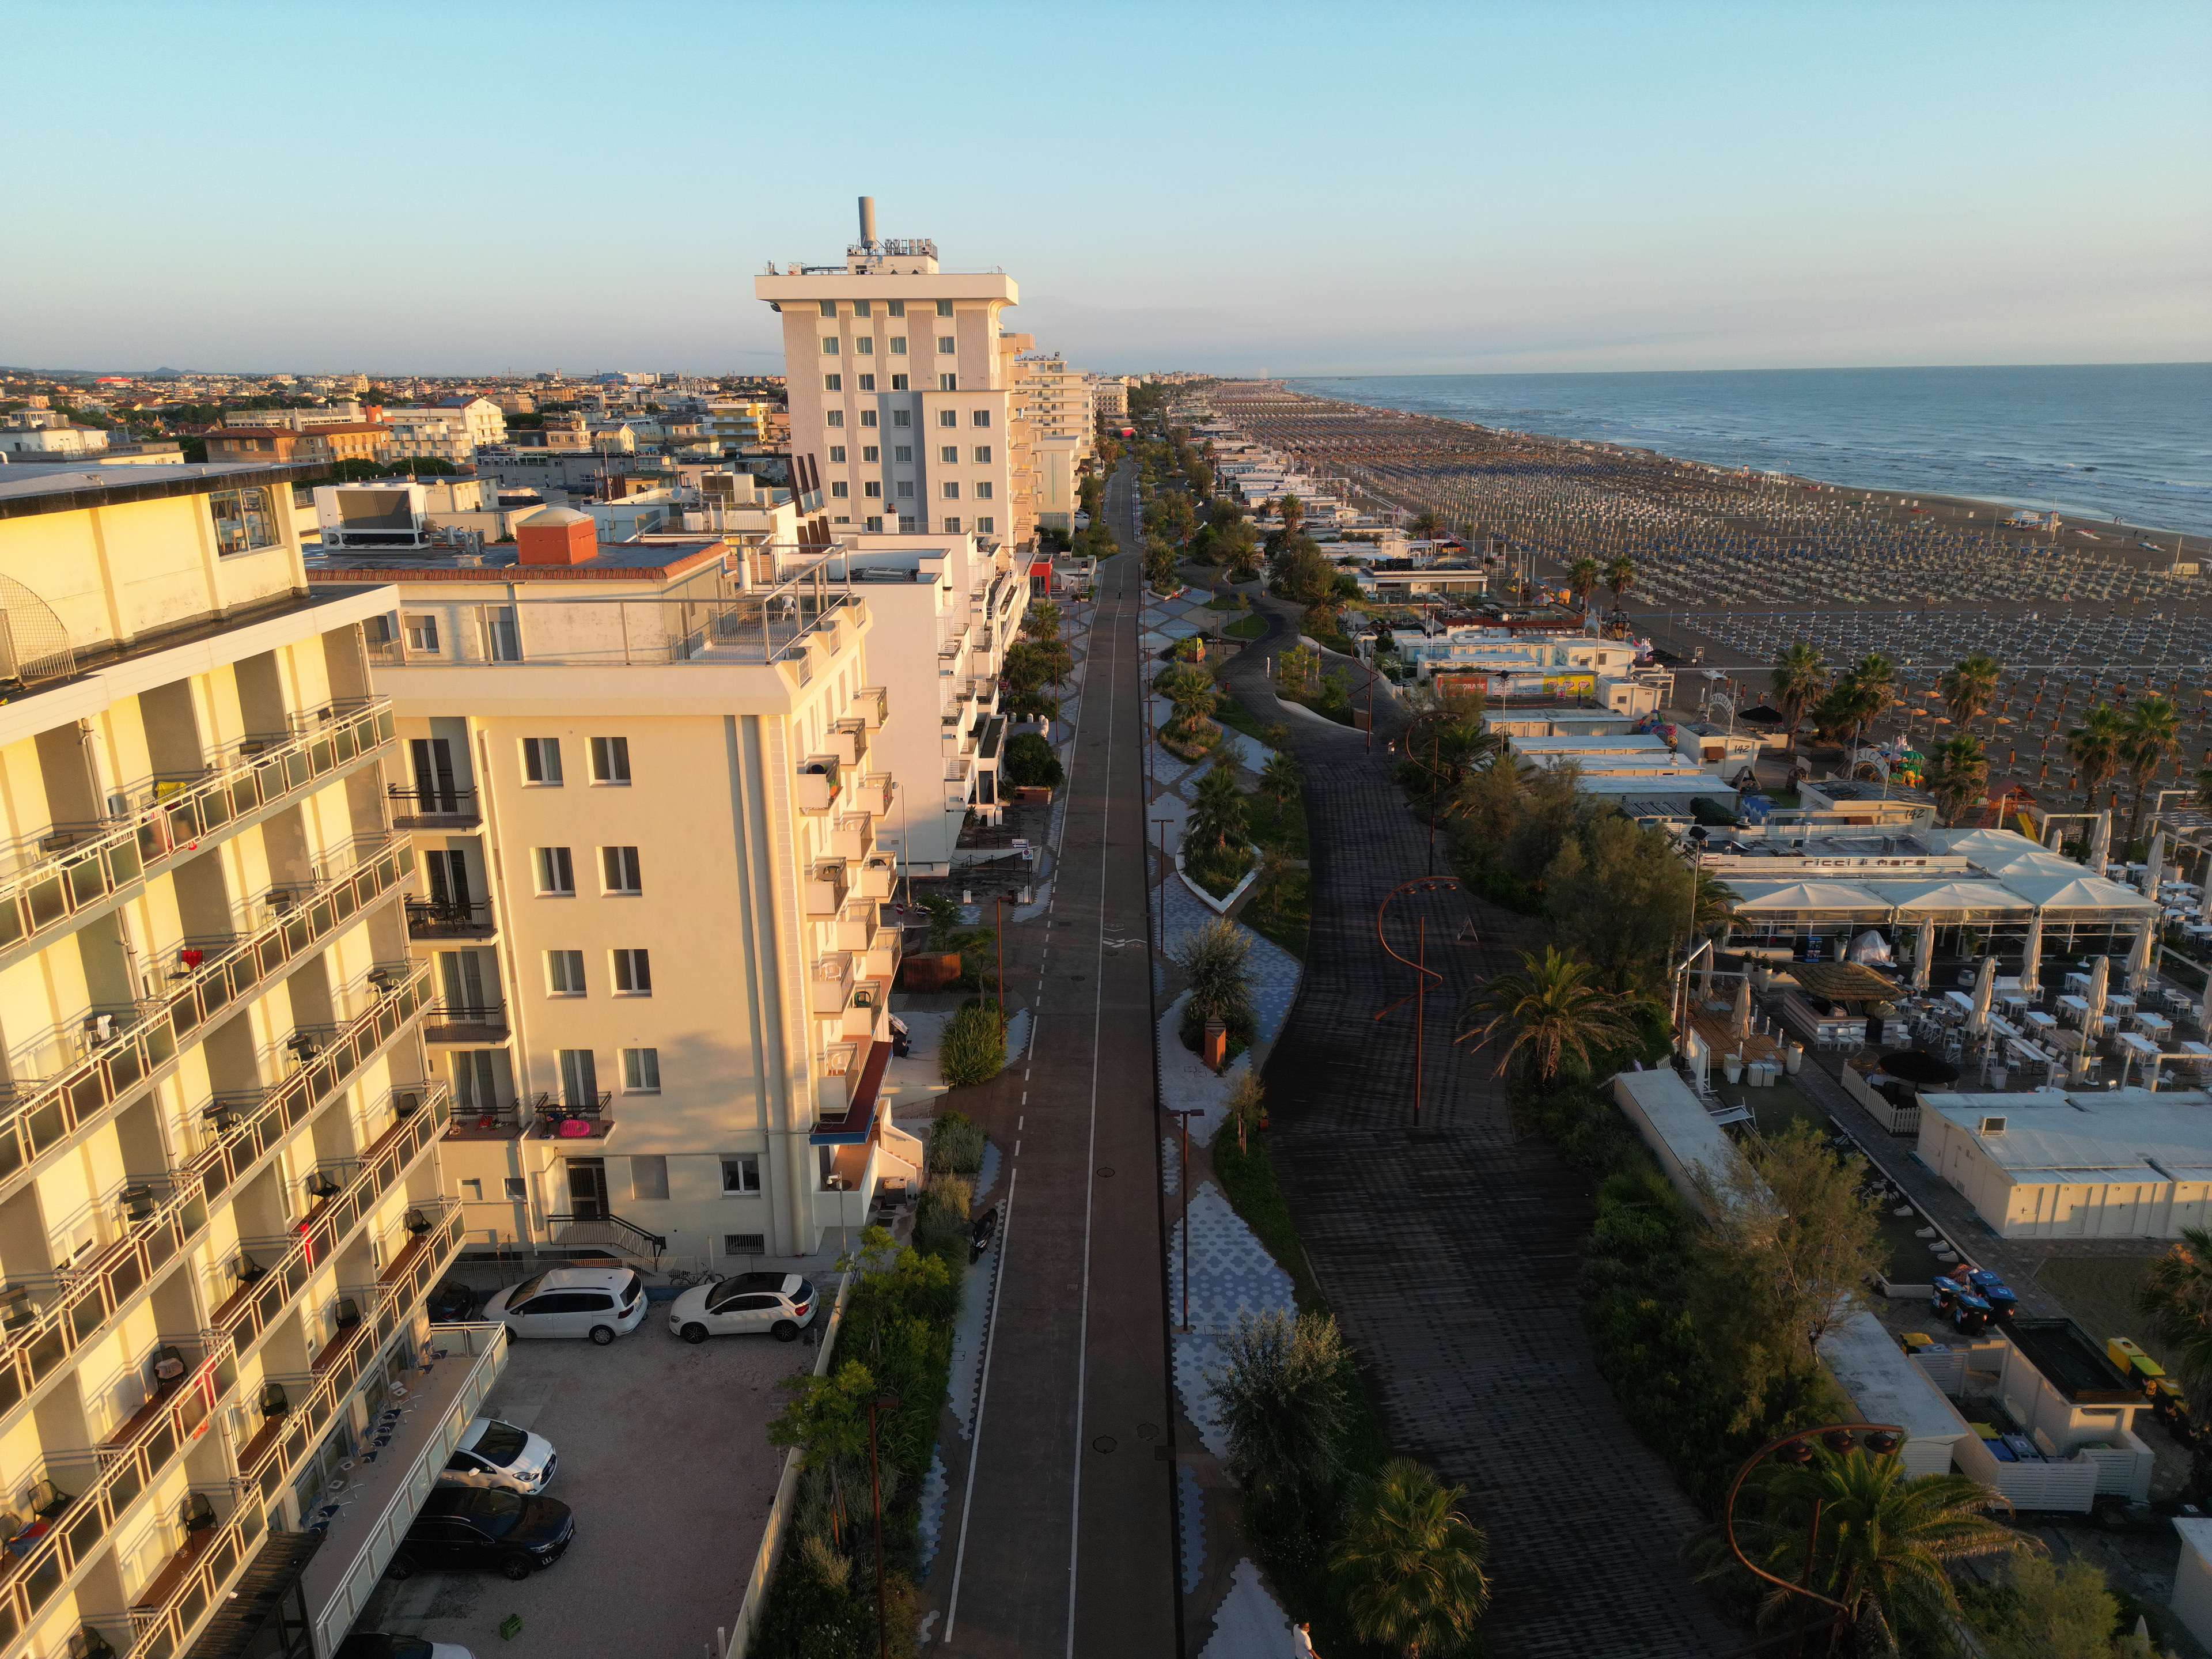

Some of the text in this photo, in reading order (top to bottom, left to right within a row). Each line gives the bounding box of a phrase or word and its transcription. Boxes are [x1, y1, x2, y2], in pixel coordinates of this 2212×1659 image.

[1734, 745, 1750, 754] 142
[1857, 750, 1886, 772] RICCI
[1905, 809, 1925, 819] 142
